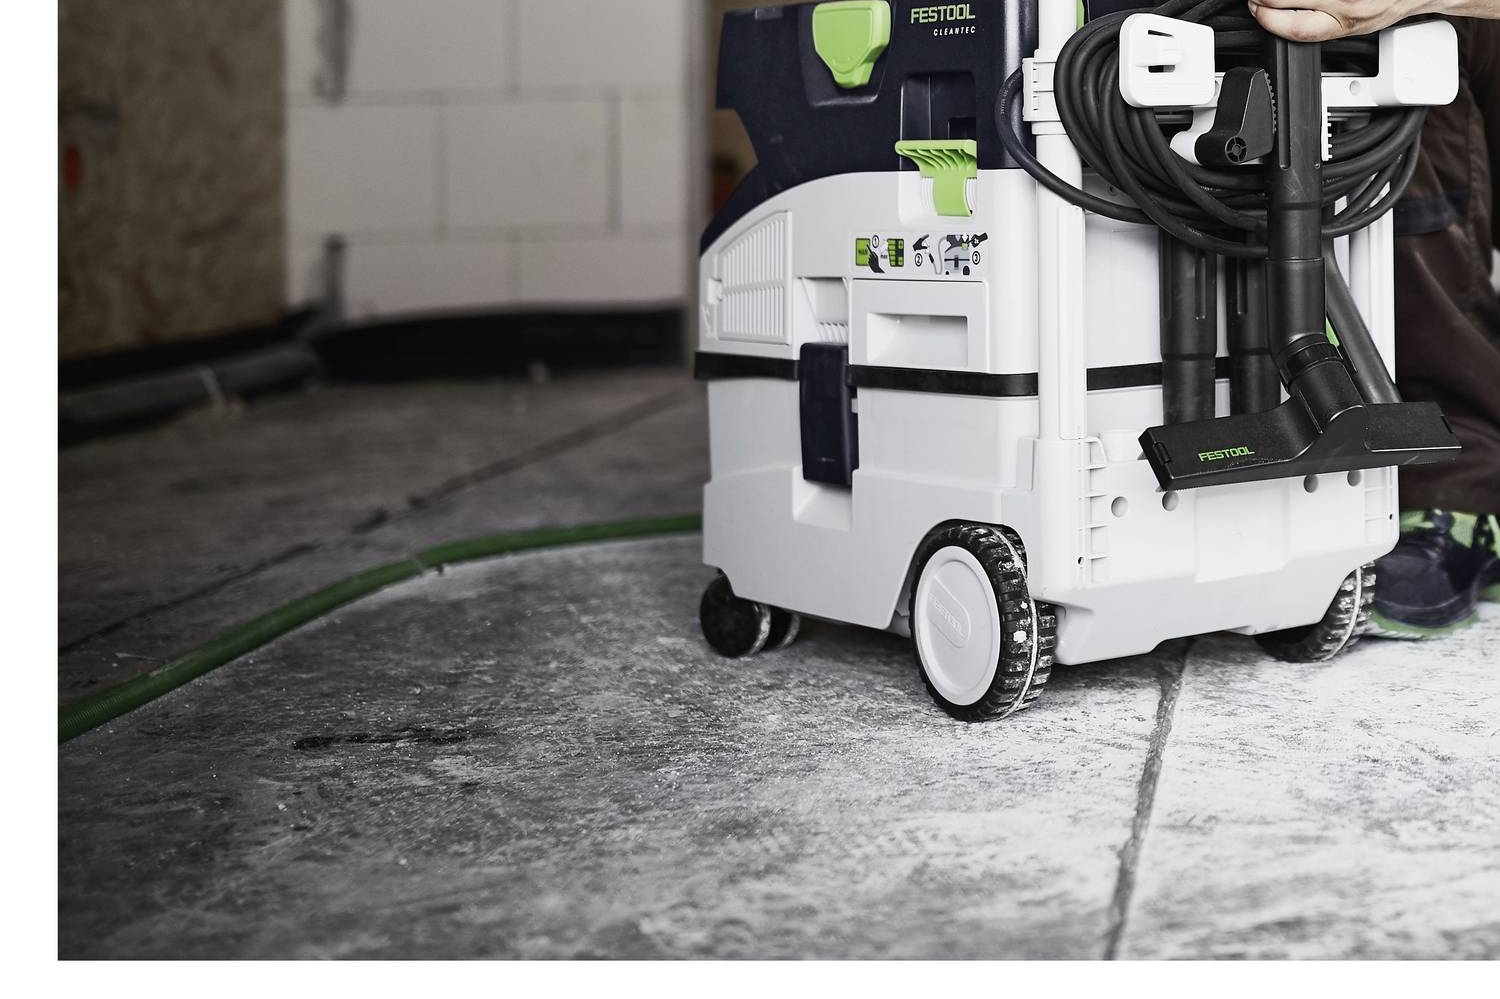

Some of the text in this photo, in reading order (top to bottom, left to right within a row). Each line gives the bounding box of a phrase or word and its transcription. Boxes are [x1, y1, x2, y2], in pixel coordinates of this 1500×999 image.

[910, 4, 976, 24] FESTOOL
[933, 26, 976, 36] CLEANTEC
[1198, 446, 1255, 461] FESTOOL
